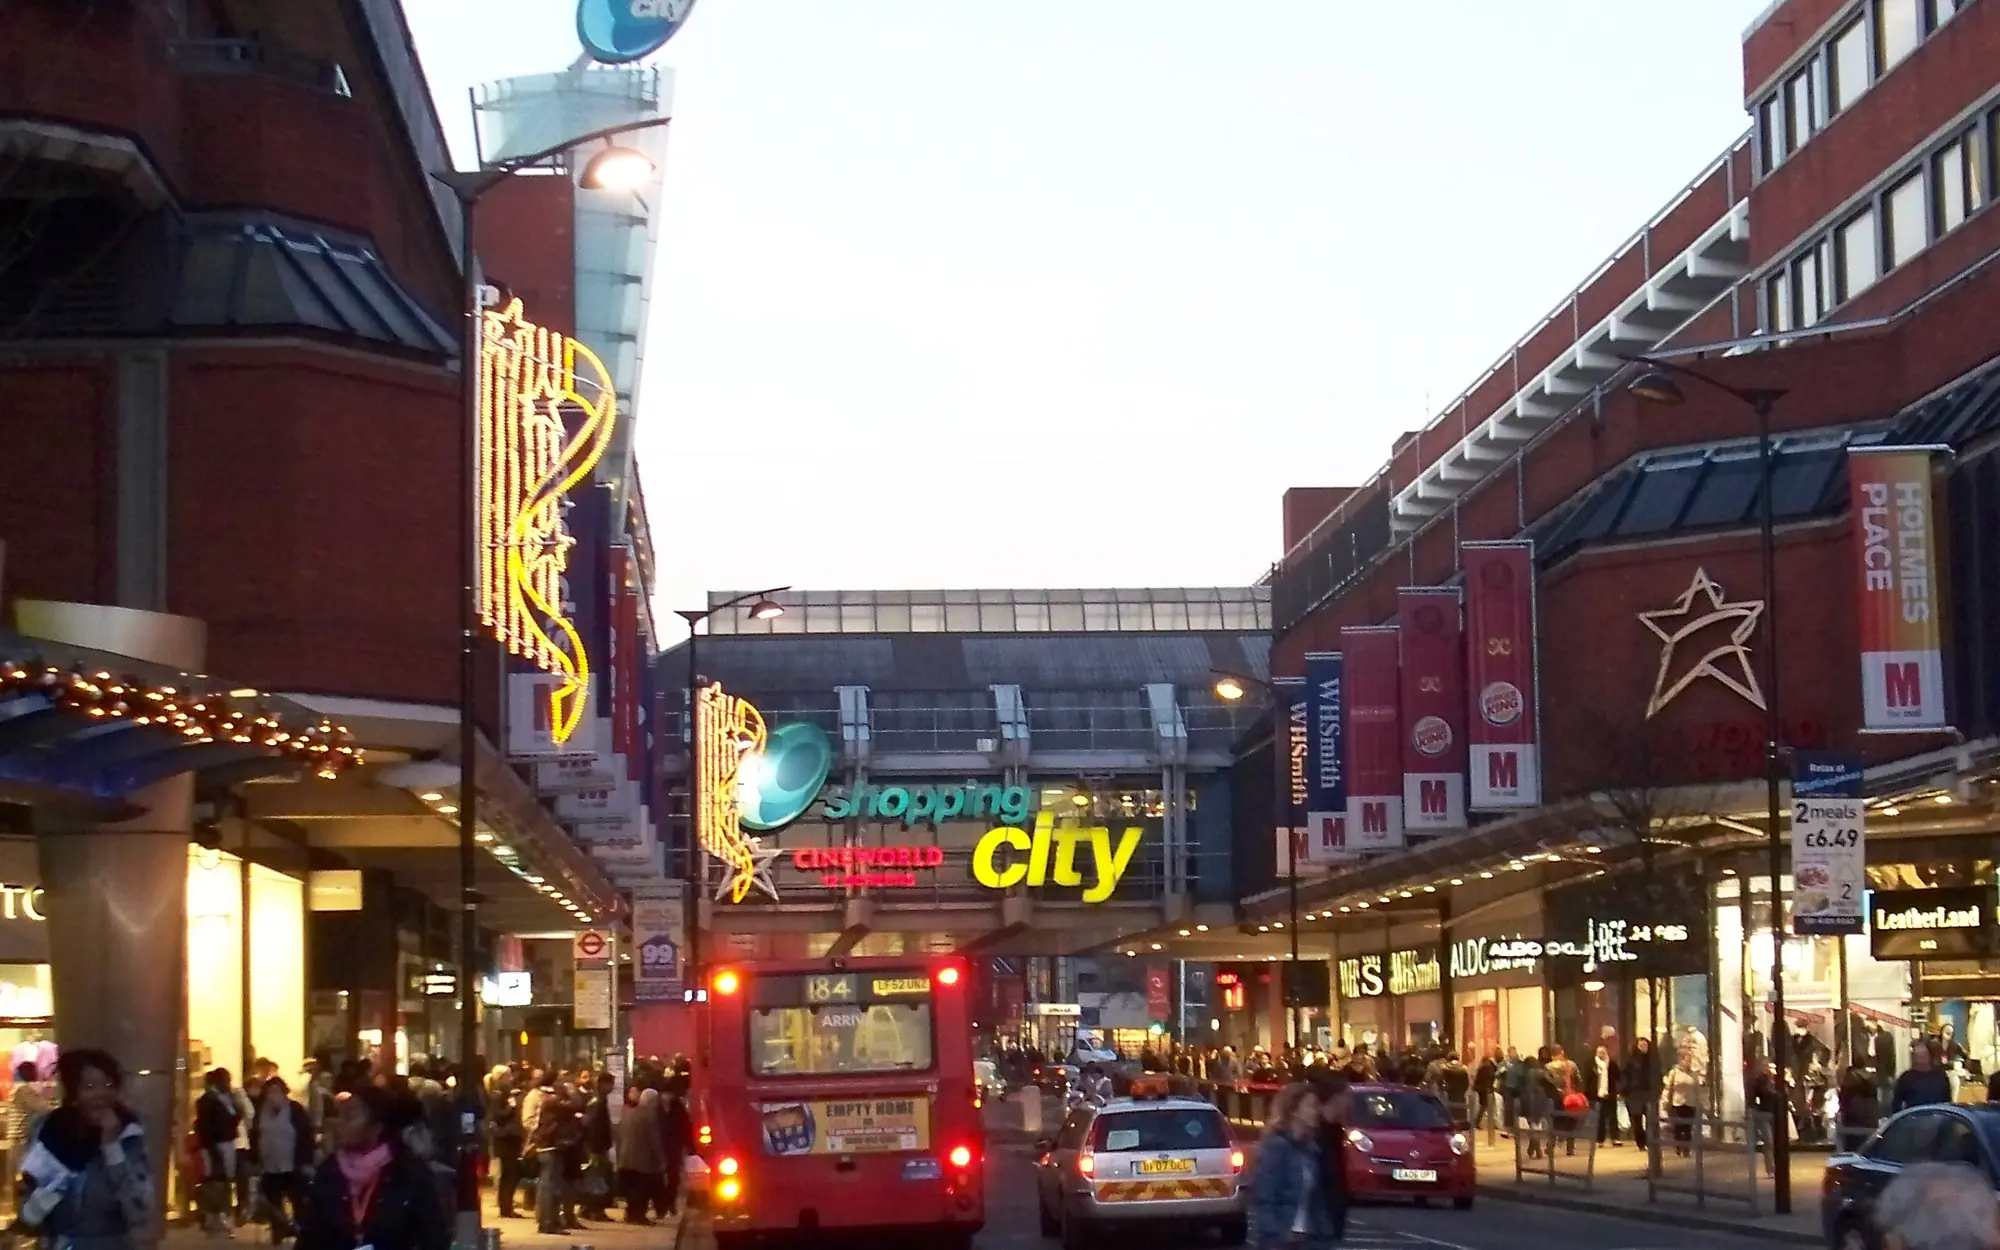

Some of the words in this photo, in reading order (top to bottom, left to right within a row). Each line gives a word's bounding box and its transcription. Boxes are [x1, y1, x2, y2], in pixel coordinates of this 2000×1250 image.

[1860, 482, 1894, 591] PLACE
[1895, 482, 1930, 624] HOLMES
[1884, 662, 1921, 708] M
[1319, 678, 1341, 789] WHSmith
[1289, 701, 1308, 805] WHSmith
[1488, 752, 1518, 788] M
[823, 779, 1032, 825] shopping
[1420, 780, 1447, 813] M
[1363, 803, 1387, 832] M
[1795, 802, 1809, 823] 2
[1810, 804, 1858, 819] meals
[1322, 818, 1346, 846] M
[1806, 829, 1859, 848] £6.49
[973, 811, 1144, 903] city
[1842, 883, 1852, 900] 2
[1876, 905, 1980, 930] LeatherLand
[809, 976, 852, 1002] 184
[822, 1014, 867, 1027] ARRIV
[826, 1101, 871, 1117] EMPTY
[876, 1101, 914, 1116] HOME
